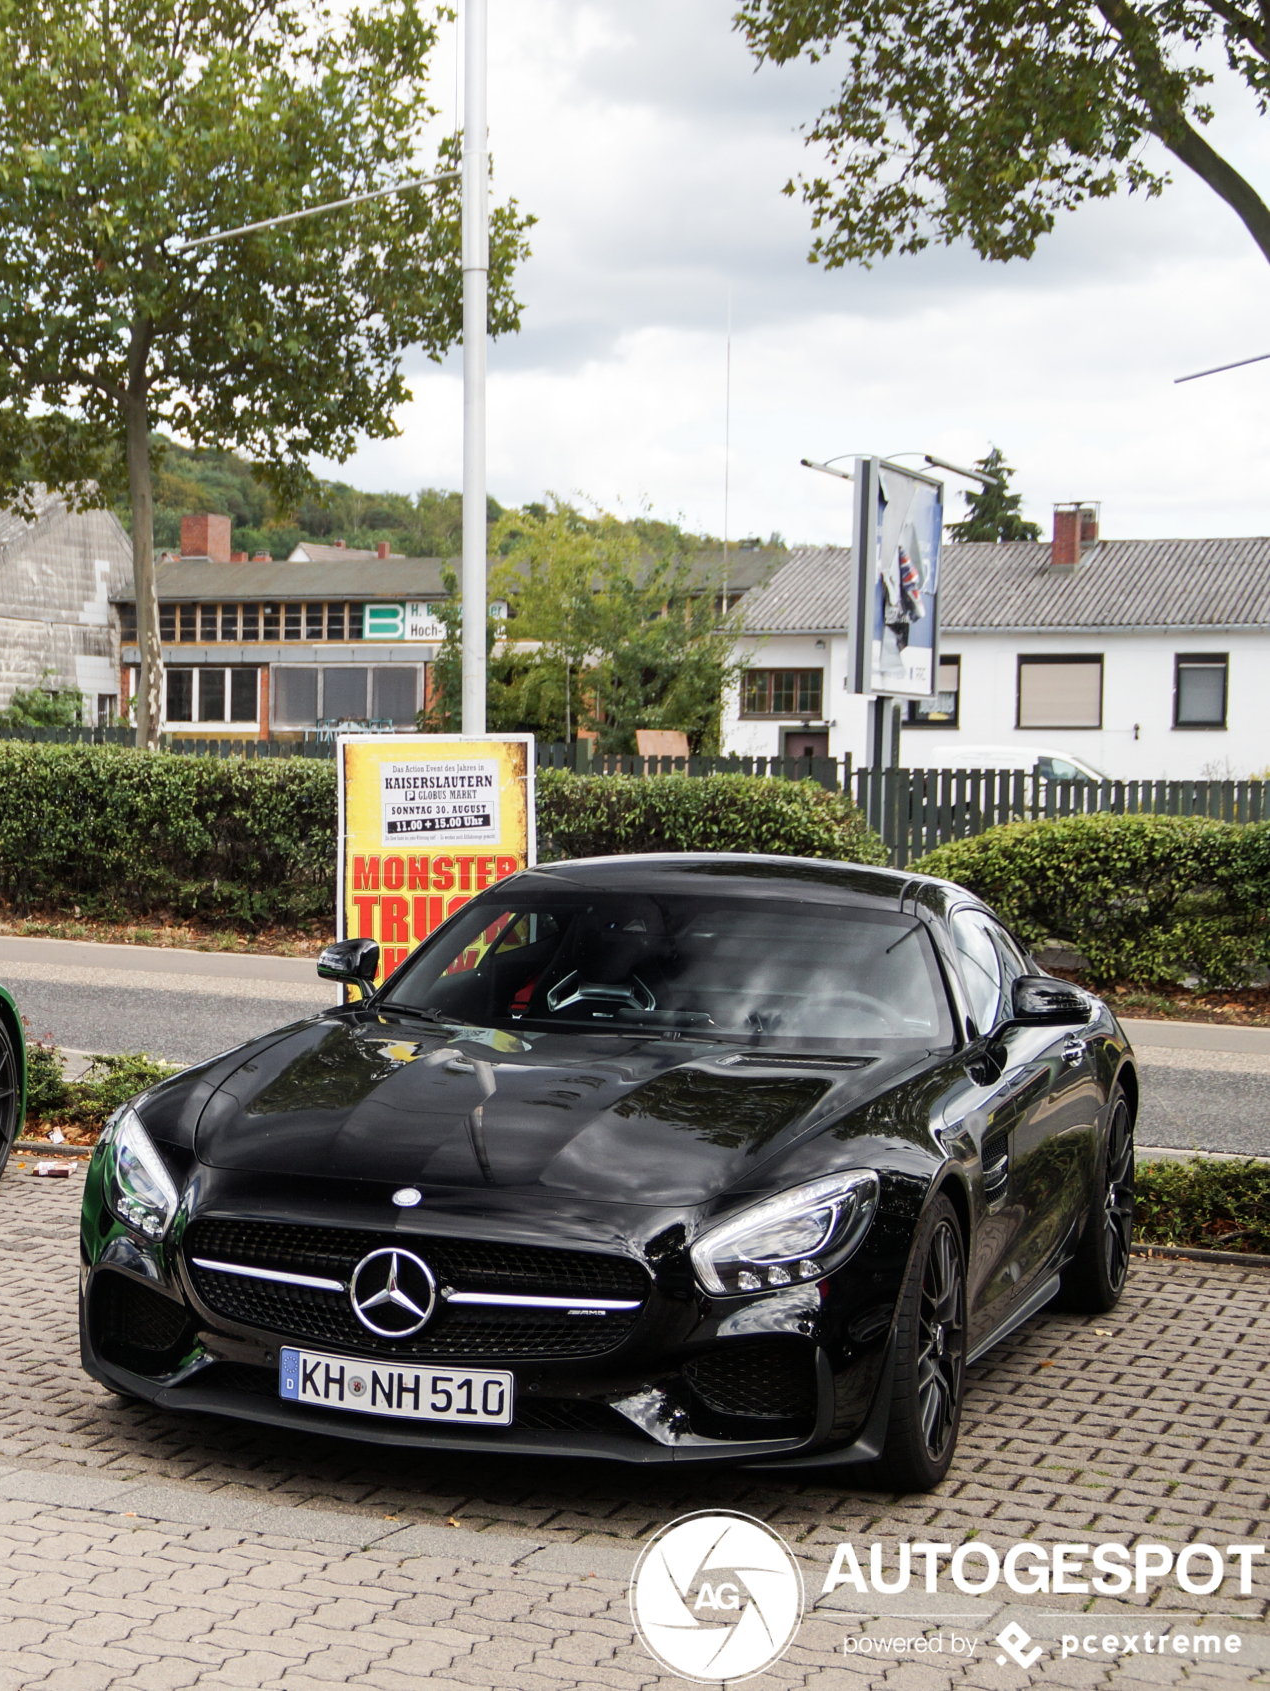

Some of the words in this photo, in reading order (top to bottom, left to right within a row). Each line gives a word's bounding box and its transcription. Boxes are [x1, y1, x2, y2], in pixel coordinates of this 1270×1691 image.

[411, 623, 443, 637] Hoch-
[392, 765, 404, 773] Das
[405, 764, 425, 773] Action
[426, 764, 443, 773] Event
[444, 763, 455, 772] des
[456, 763, 477, 774] Jahres
[478, 763, 485, 771] in
[385, 775, 493, 789] KAISERSLAUTERN
[418, 790, 447, 800] GLOBUS
[449, 789, 477, 800] MARKT
[391, 805, 433, 815] SONNTAG
[435, 805, 450, 814] 30.
[452, 804, 487, 814] AUGUST
[396, 820, 423, 832] 11.00
[434, 818, 462, 829] 15.00
[463, 816, 484, 826] Uhr
[352, 855, 519, 891] MONSTER
[286, 1378, 294, 1390] D
[302, 1358, 345, 1402] KH
[371, 1369, 421, 1411] NH
[431, 1376, 505, 1416] 510
